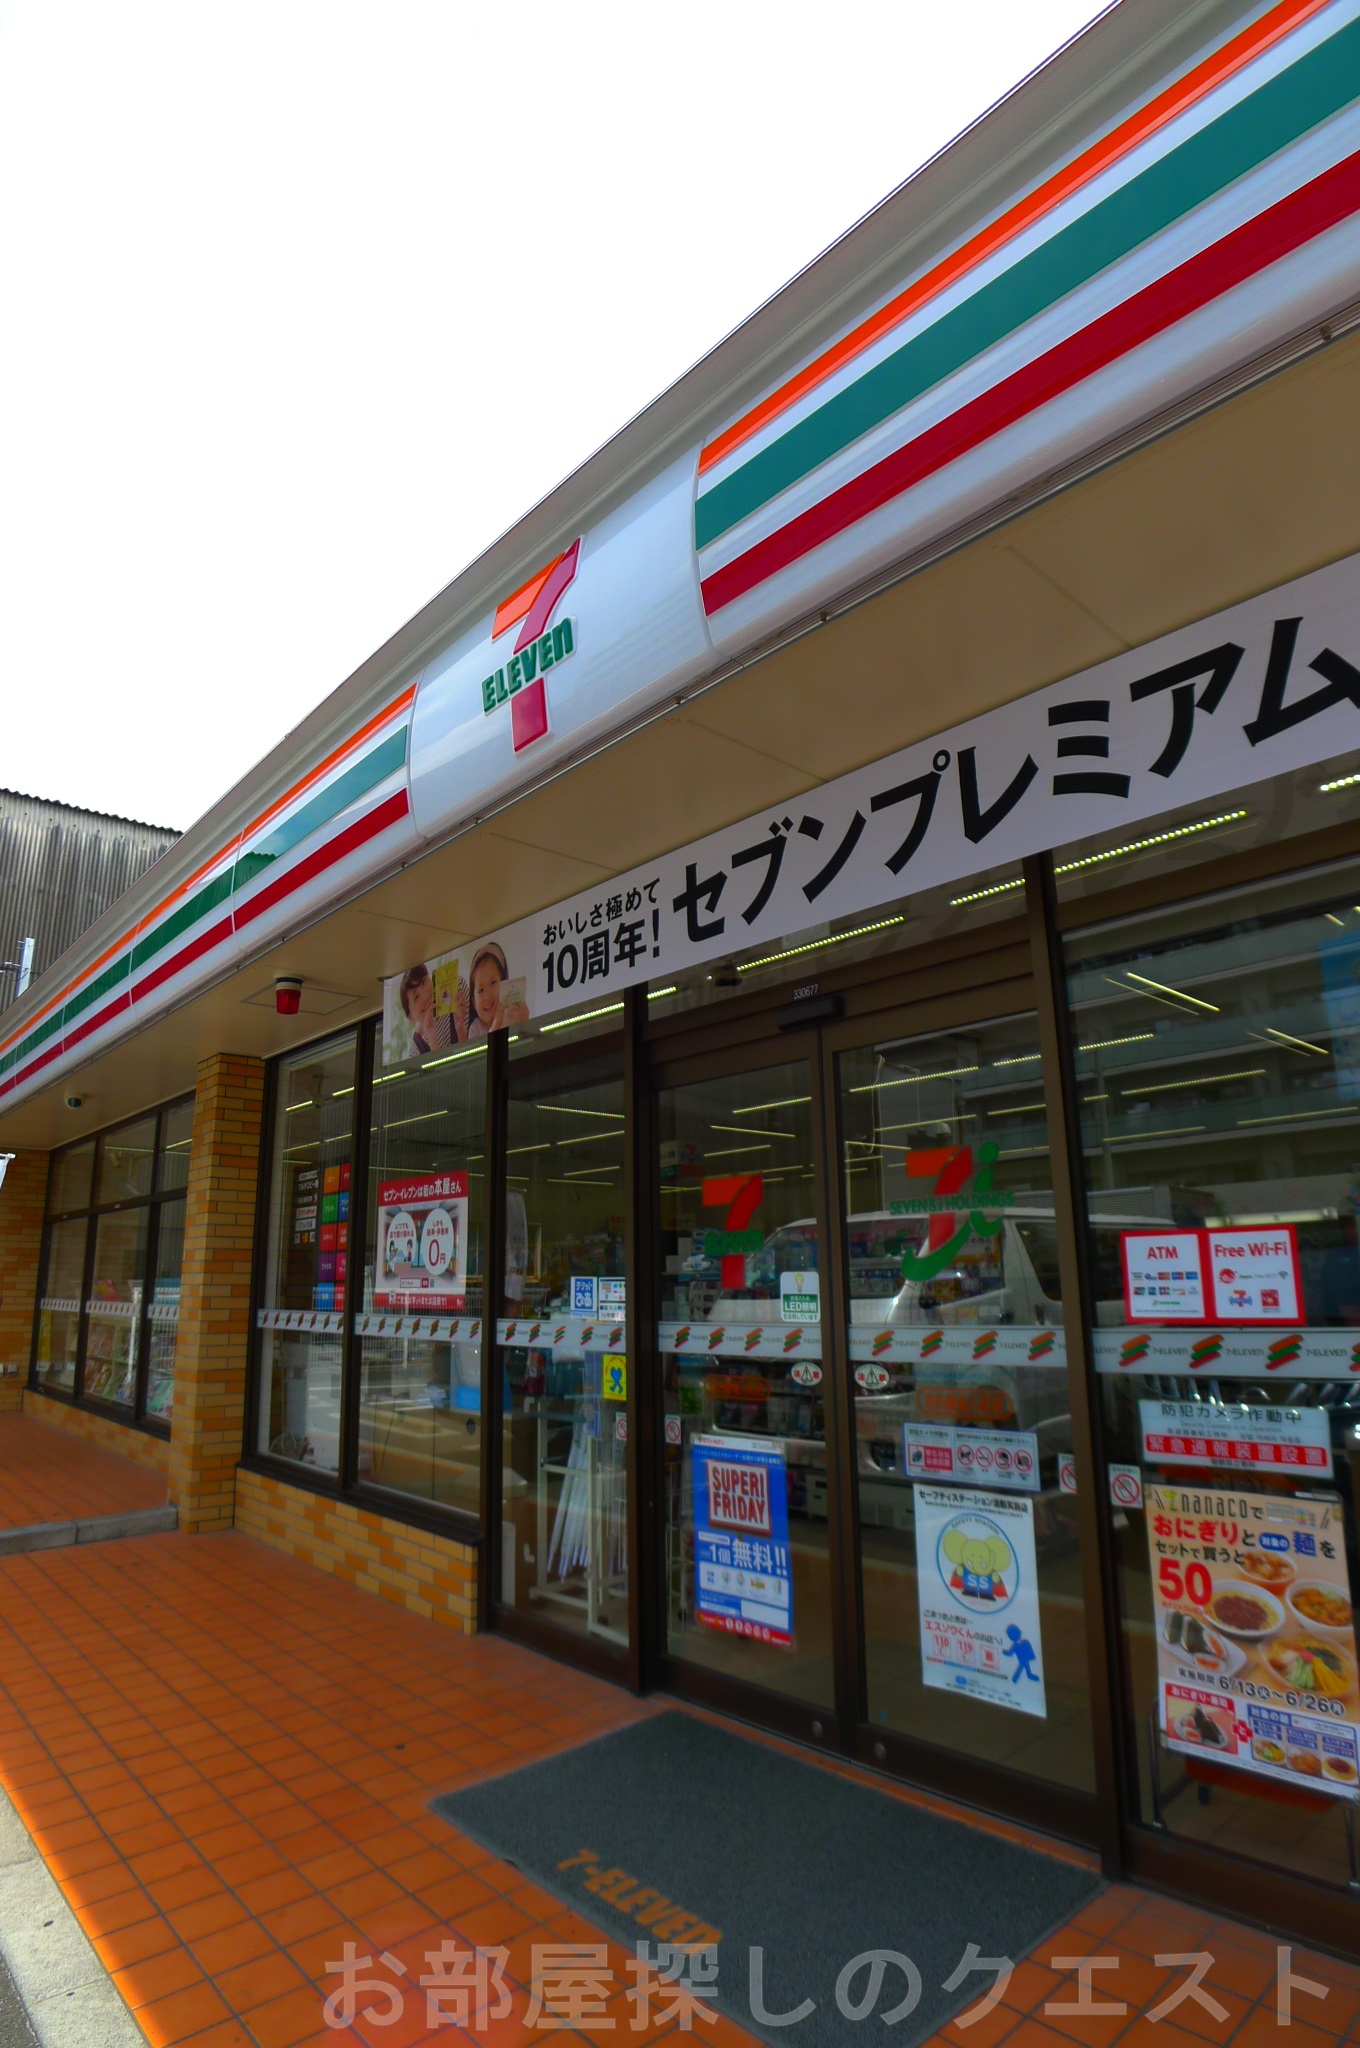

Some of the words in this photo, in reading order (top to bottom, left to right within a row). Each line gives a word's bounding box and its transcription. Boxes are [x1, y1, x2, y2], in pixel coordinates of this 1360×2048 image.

[482, 616, 575, 715] ELEVEN
[672, 616, 1360, 943] セブンプレミアム
[543, 878, 661, 946] おいしさ極めて
[428, 1239, 446, 1267] 0円
[1147, 1246, 1178, 1260] ATM
[1214, 1244, 1245, 1258] Free
[1247, 1241, 1288, 1257] Wi-Fi
[575, 1292, 592, 1307] ぴあ
[785, 1301, 817, 1312] LED照明
[1153, 1347, 1188, 1355] 7-ELEVEN
[1226, 1348, 1264, 1357] 7-ELEVEN
[1306, 1349, 1347, 1357] 7-ELEVEN
[1162, 1404, 1302, 1424] 防犯カメラ作動中
[1148, 1437, 1326, 1465] 緊急通報装置設置
[712, 1492, 765, 1524] FRIDAY
[1155, 1541, 1246, 1566] セットで買うと
[967, 1575, 990, 1590] SS
[1158, 1557, 1213, 1606] 50
[935, 1635, 950, 1646] 110
[958, 1641, 973, 1652] 119
